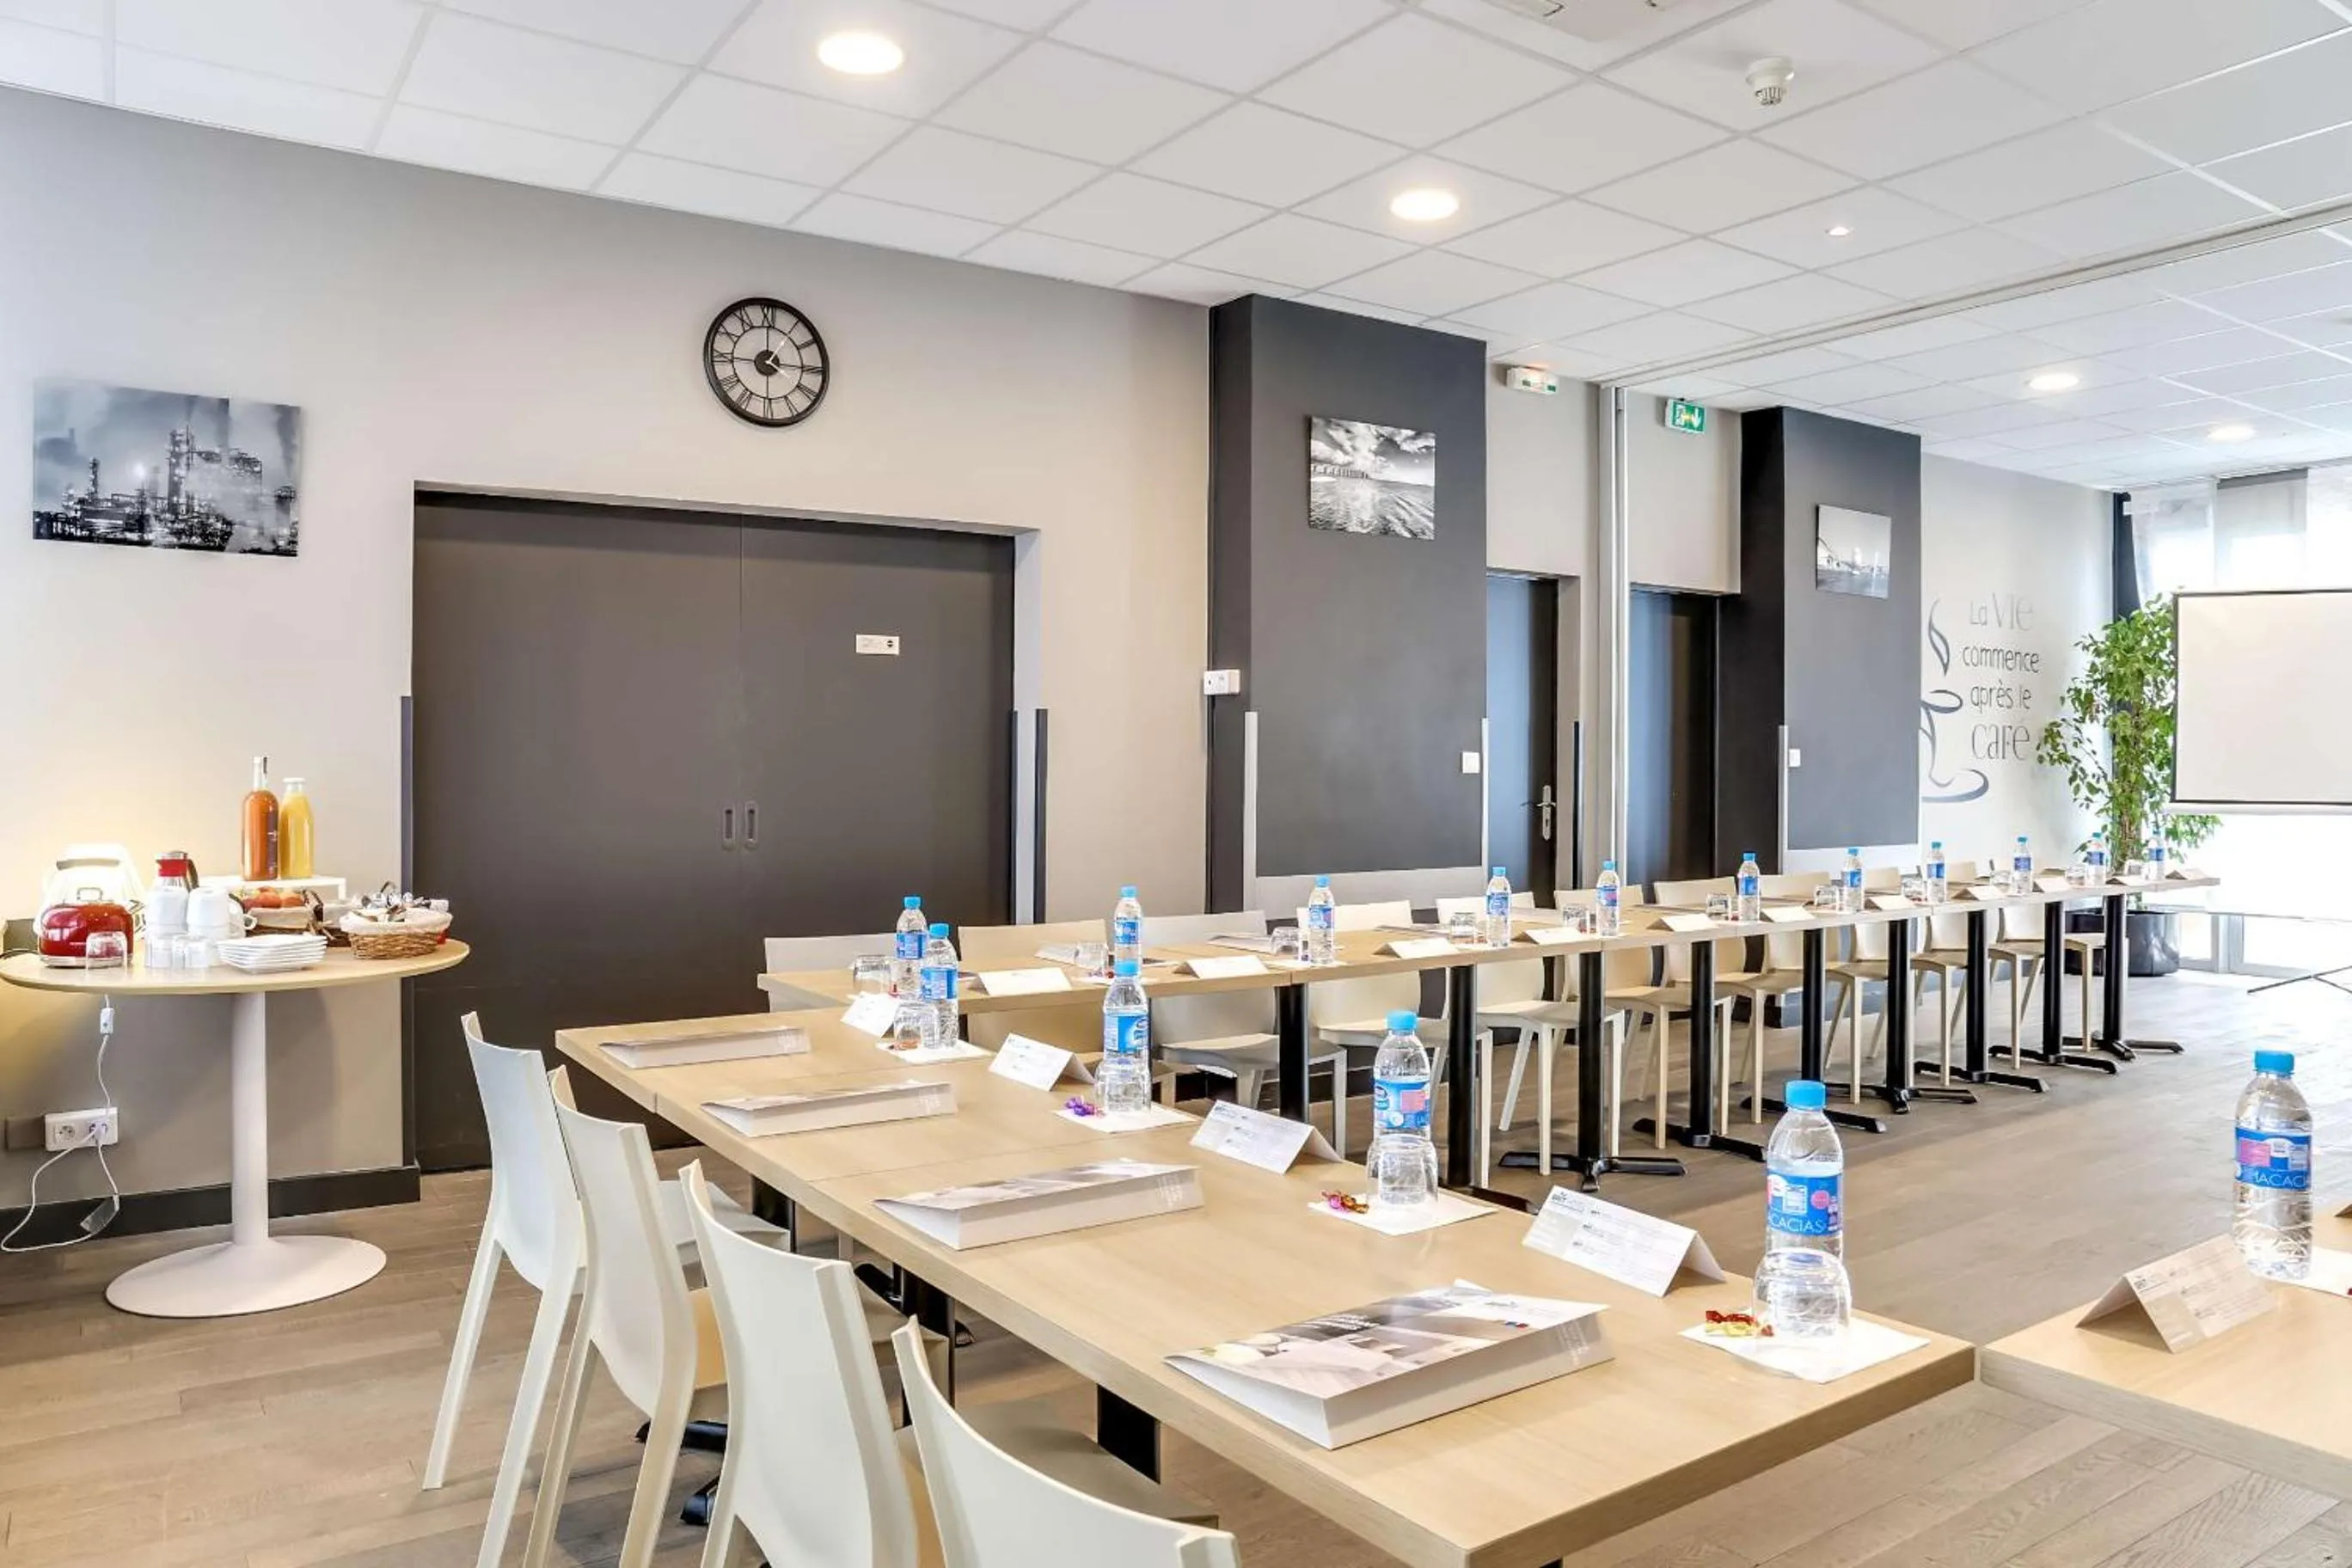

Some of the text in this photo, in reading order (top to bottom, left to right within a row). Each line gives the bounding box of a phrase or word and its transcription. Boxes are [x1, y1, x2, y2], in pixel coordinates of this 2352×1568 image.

[1969, 600, 1988, 626] La
[1962, 646, 2041, 674] commence
[1970, 678, 2032, 713] après le
